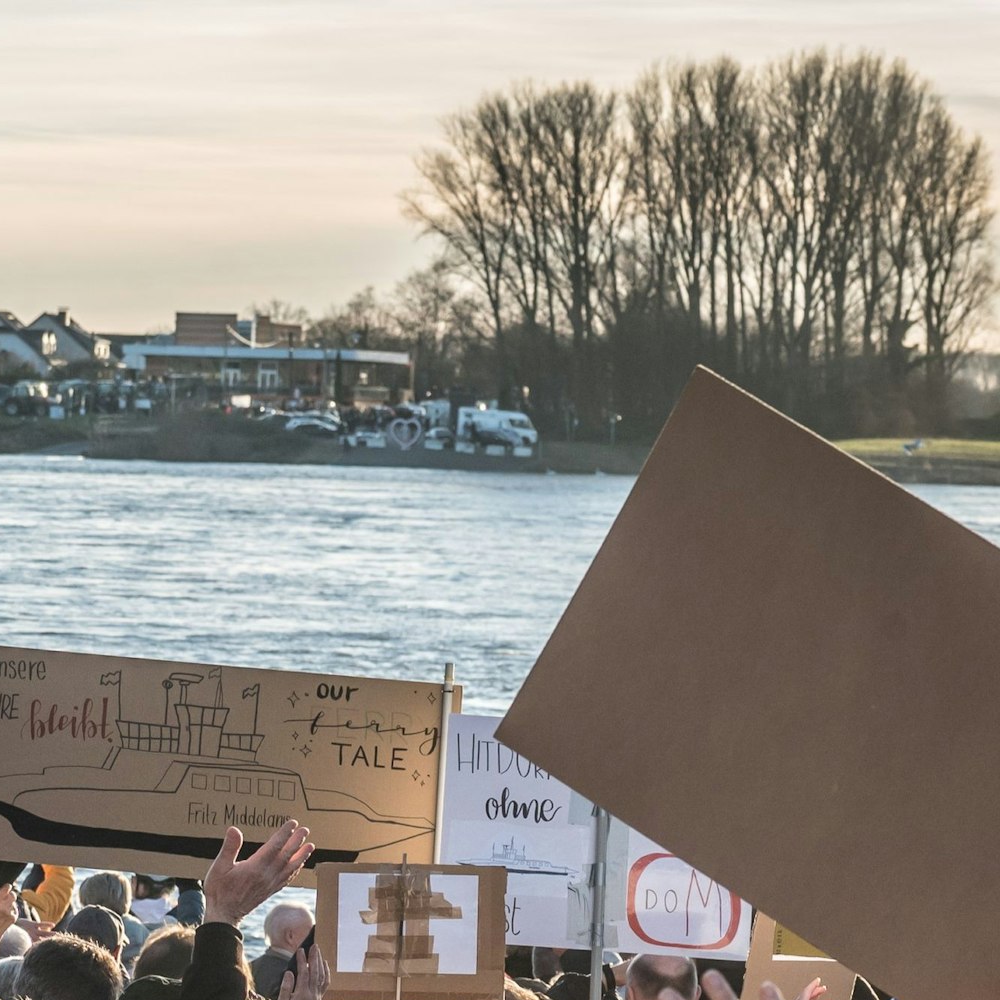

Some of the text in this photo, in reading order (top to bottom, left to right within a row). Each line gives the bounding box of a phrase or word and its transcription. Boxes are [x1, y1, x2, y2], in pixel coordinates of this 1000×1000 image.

[316, 682, 360, 702] our
[283, 710, 439, 757] ferry
[331, 741, 408, 771] TALE
[187, 801, 218, 826] Fritz
[485, 786, 562, 824] ohne
[644, 868, 723, 938] DOM
